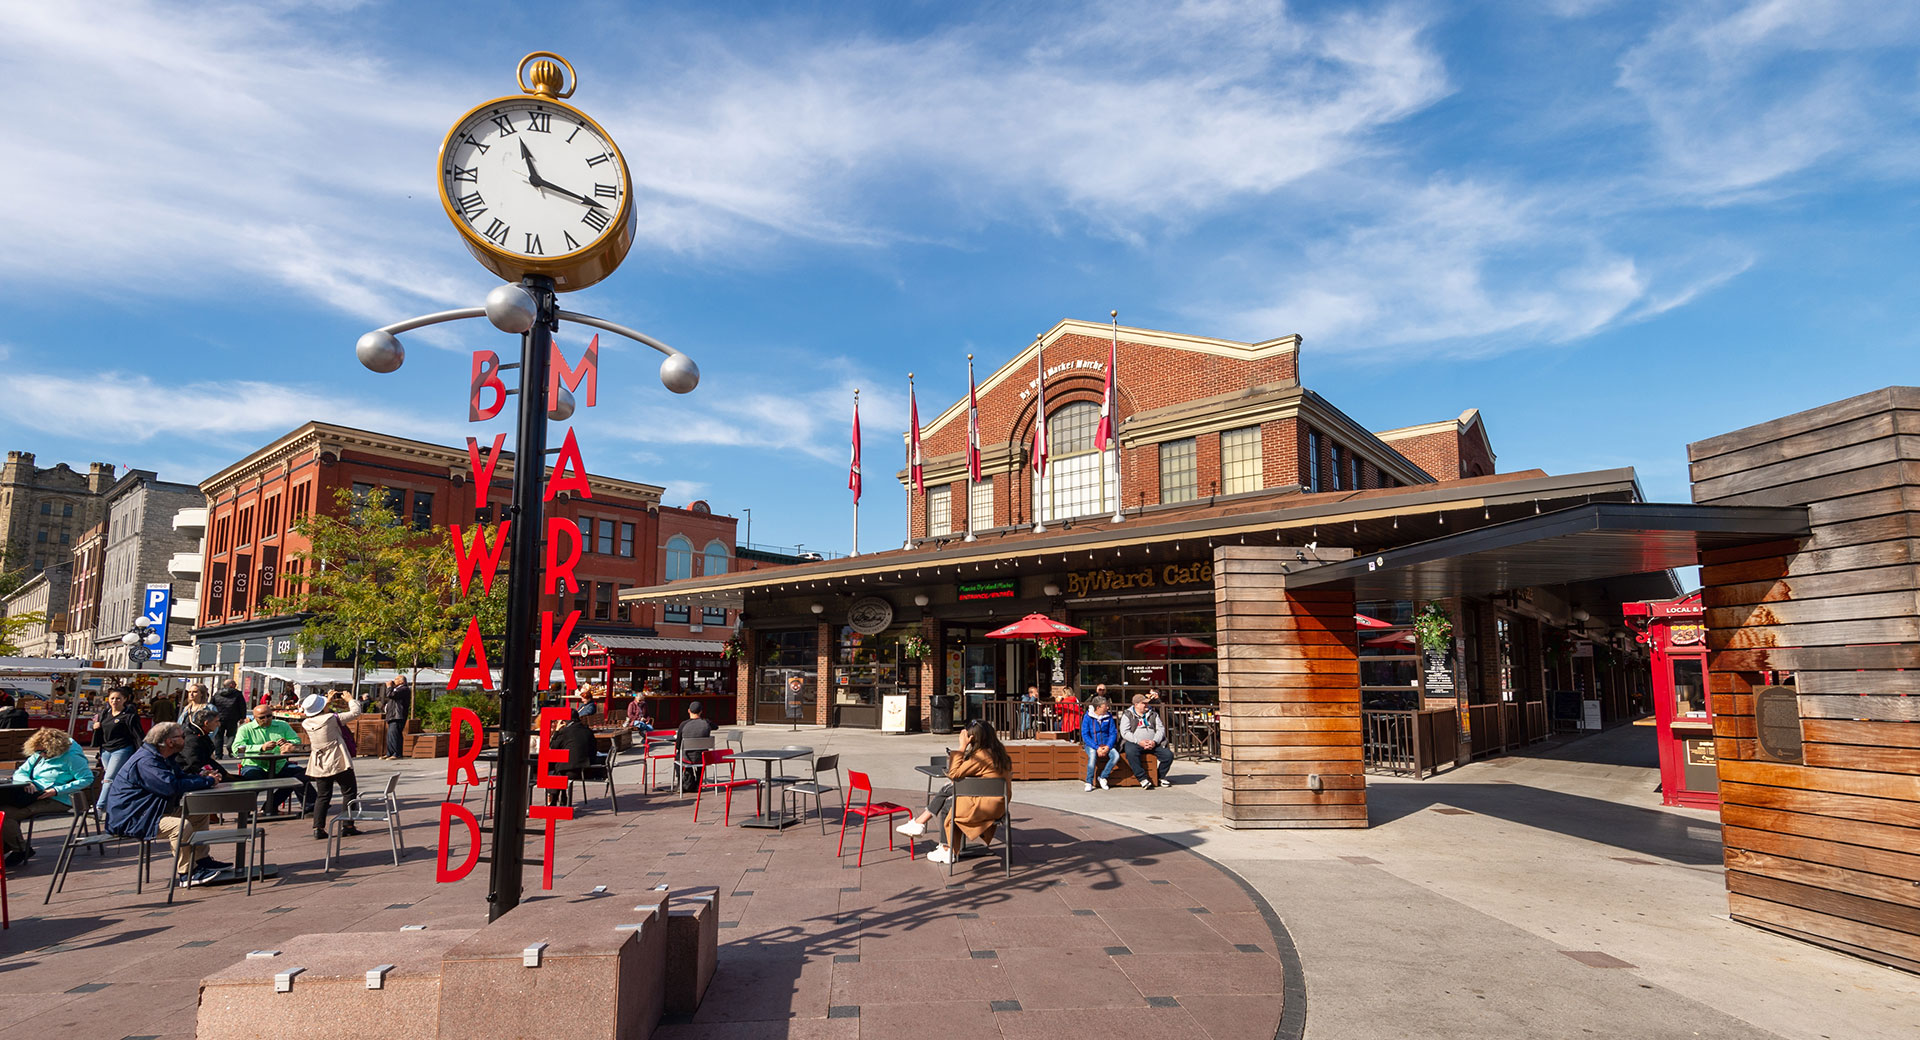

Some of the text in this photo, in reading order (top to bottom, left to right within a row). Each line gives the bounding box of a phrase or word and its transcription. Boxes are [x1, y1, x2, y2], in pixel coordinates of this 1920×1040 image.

[490, 114, 517, 138] XI
[527, 111, 552, 133] XII
[464, 134, 490, 155] X
[565, 126, 581, 144] I
[585, 152, 609, 168] II
[454, 164, 478, 184] IX
[595, 182, 617, 200] III
[457, 190, 488, 222] VIII
[483, 217, 510, 246] VII
[563, 230, 581, 251] V
[525, 232, 544, 255] VI
[1047, 361, 1075, 377] Market
[236, 573, 247, 592] EQ3
[263, 566, 274, 586] EQ3
[1067, 560, 1213, 598] ByWard Café
[212, 580, 223, 598] EQ3
[149, 591, 165, 608] P
[436, 350, 511, 884] BYWARD
[529, 333, 599, 890] MARKET
[278, 640, 290, 655] EQ3
